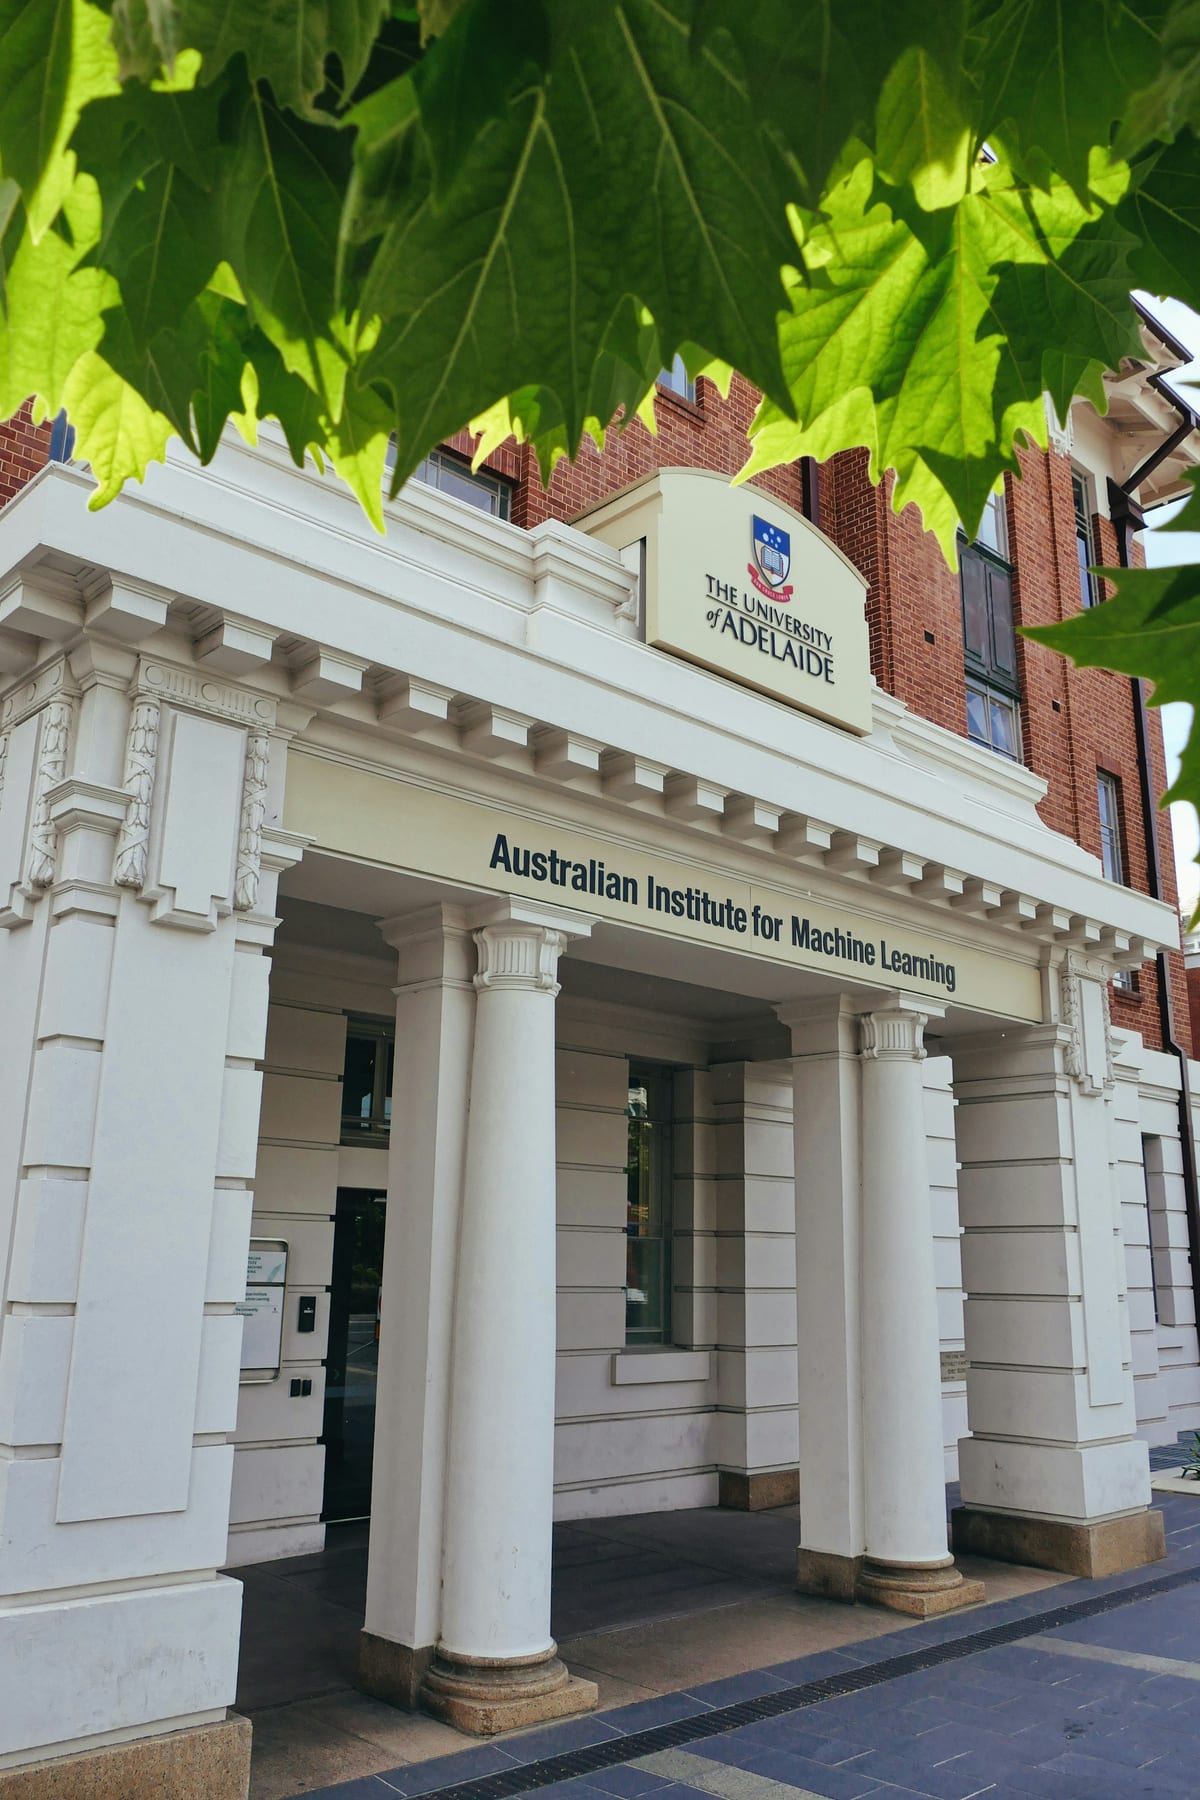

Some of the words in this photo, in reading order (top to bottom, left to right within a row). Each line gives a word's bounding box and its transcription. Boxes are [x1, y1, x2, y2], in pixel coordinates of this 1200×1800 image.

[706, 574, 738, 605] THE
[744, 593, 833, 651] UNIVERSITY
[706, 608, 723, 628] of
[721, 611, 835, 684] ADELAIDE
[489, 833, 638, 905] Australian
[647, 875, 747, 934] Institute
[751, 905, 783, 942] for
[791, 916, 876, 967] Machine
[881, 940, 957, 992] Learning
